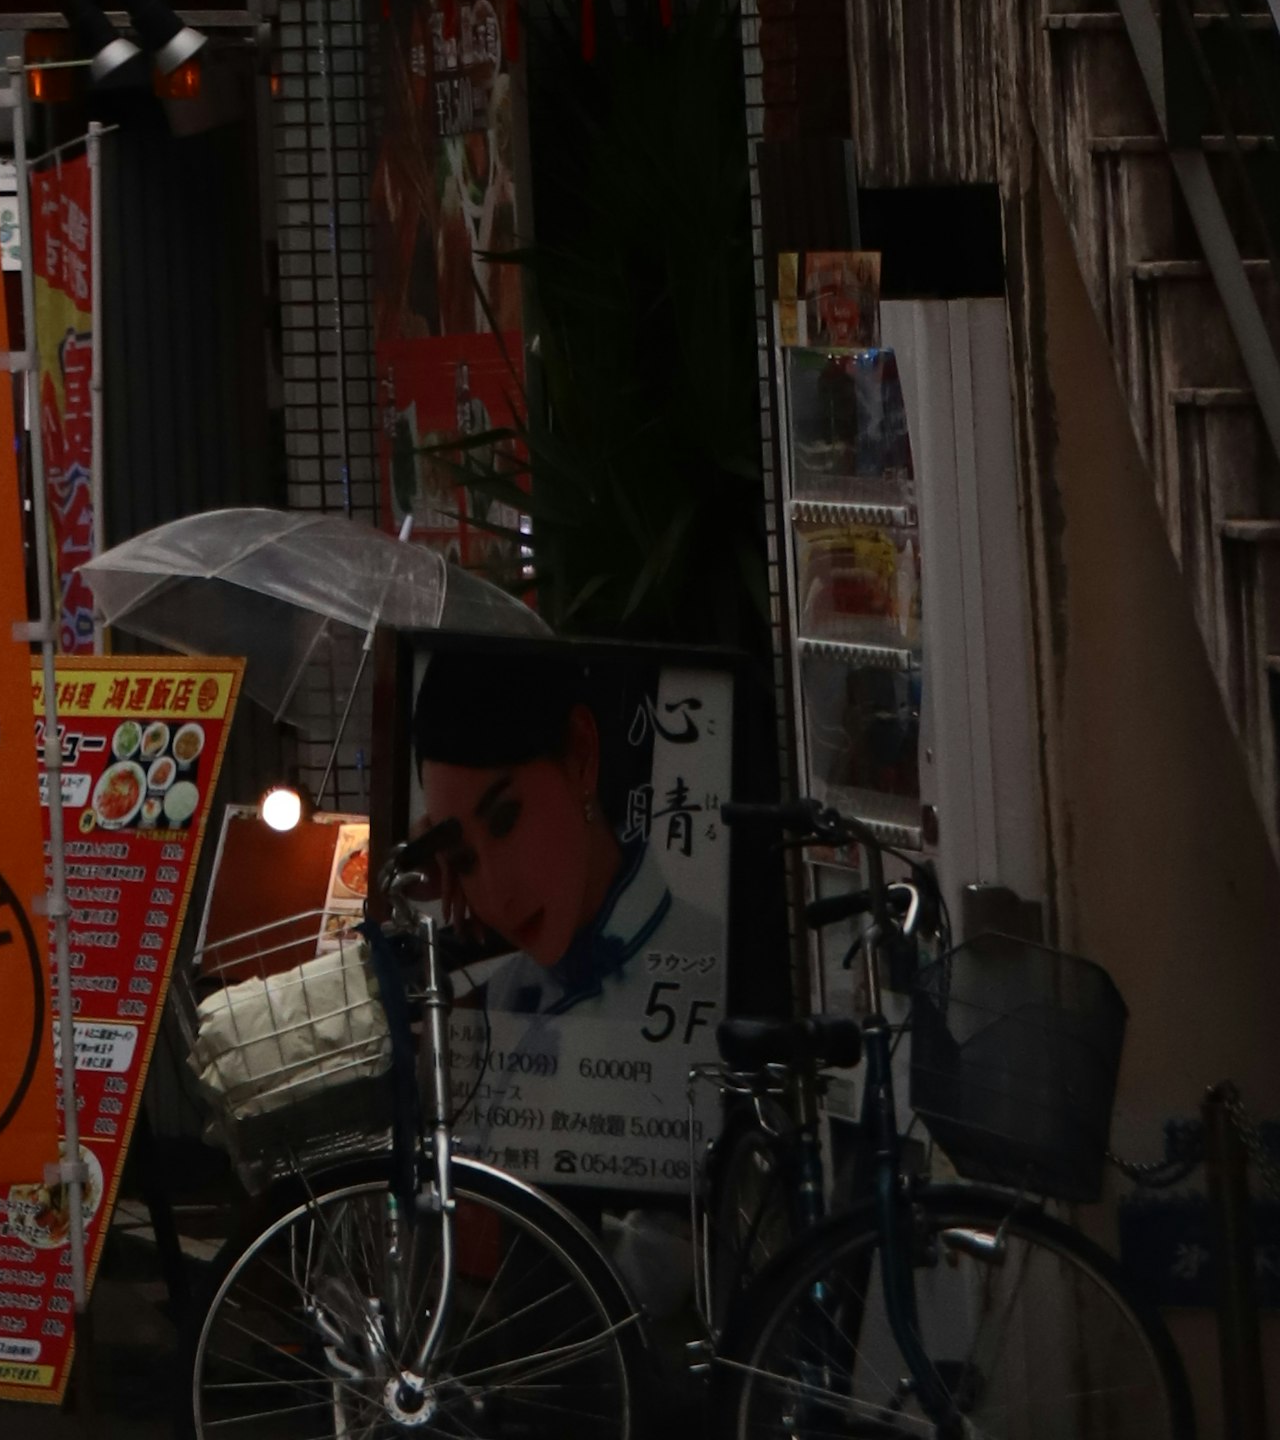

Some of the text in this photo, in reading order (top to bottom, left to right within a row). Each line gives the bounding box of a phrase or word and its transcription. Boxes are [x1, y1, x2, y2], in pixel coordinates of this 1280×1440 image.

[103, 678, 195, 712] 鴻運飯店
[645, 950, 719, 975] ラウンジ
[639, 981, 718, 1046] 5F
[579, 1058, 652, 1083] 6,000円
[551, 1111, 625, 1138] 飲み放題
